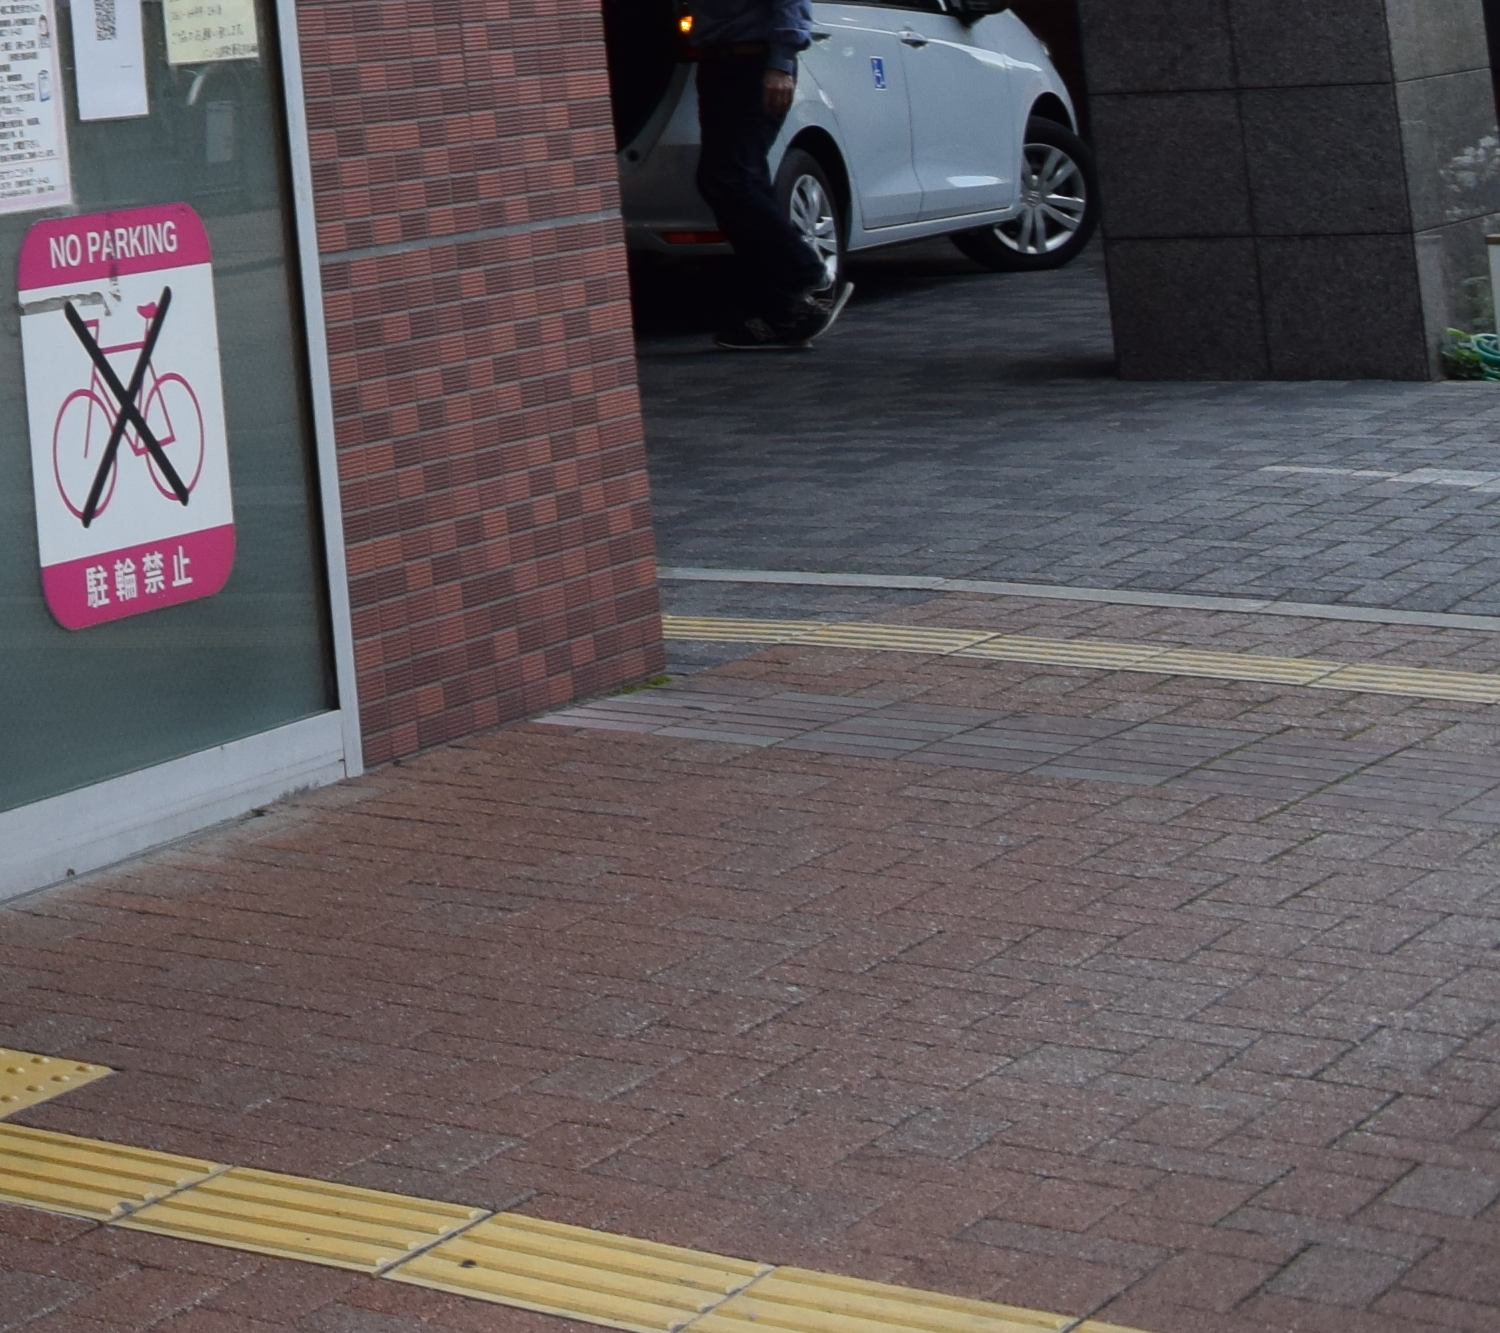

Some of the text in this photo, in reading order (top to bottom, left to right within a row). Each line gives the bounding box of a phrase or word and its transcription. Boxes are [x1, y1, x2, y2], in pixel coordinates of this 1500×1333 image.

[49, 219, 179, 269] NO PARKING
[86, 543, 193, 607] 駐輪禁止
